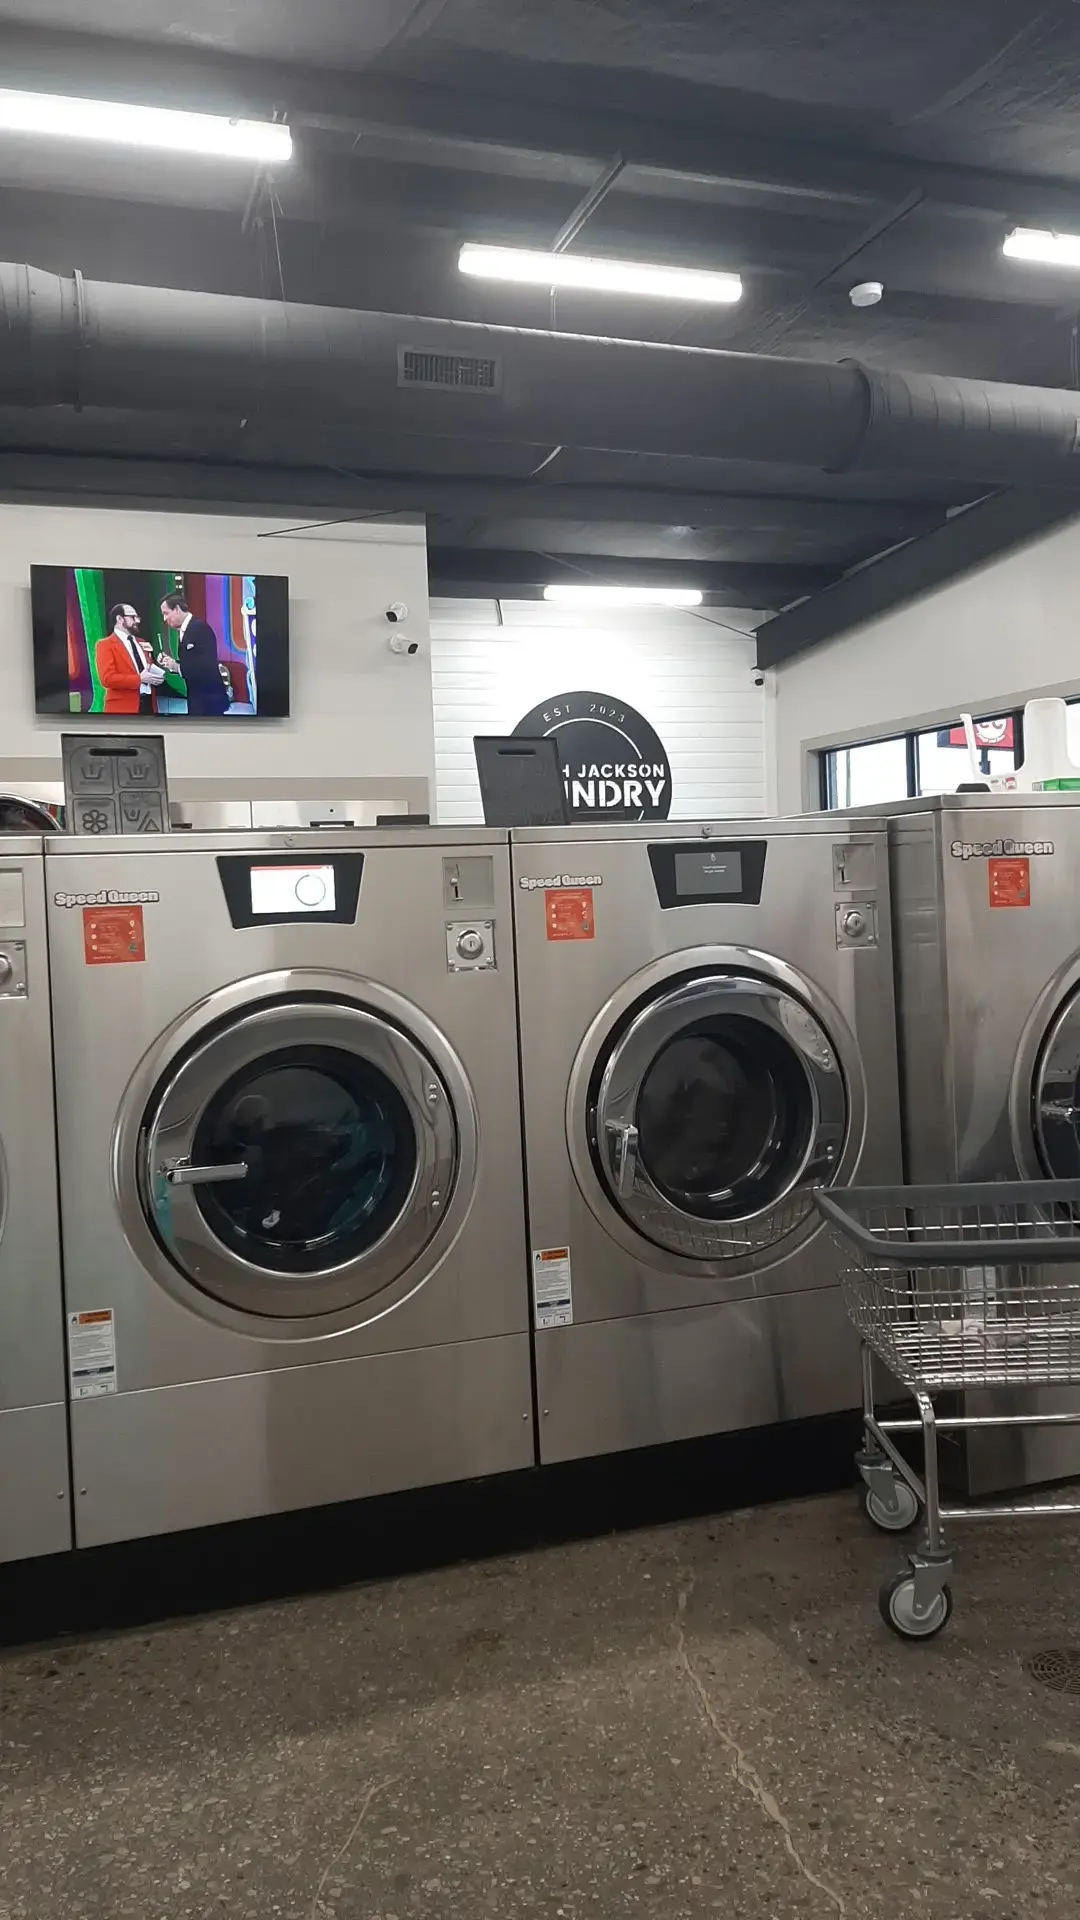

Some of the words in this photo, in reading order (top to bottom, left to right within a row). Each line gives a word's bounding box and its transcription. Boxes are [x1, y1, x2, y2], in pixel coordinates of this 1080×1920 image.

[542, 705, 571, 722] EST
[589, 703, 625, 723] 2023
[577, 763, 665, 778] JACKSON
[564, 780, 666, 808] NDRY
[951, 839, 1003, 860] Speed
[1003, 839, 1054, 856] Queen
[519, 874, 561, 891] Speed
[561, 873, 603, 887] Queen
[54, 890, 107, 908] Speed
[107, 889, 160, 904] Queen
